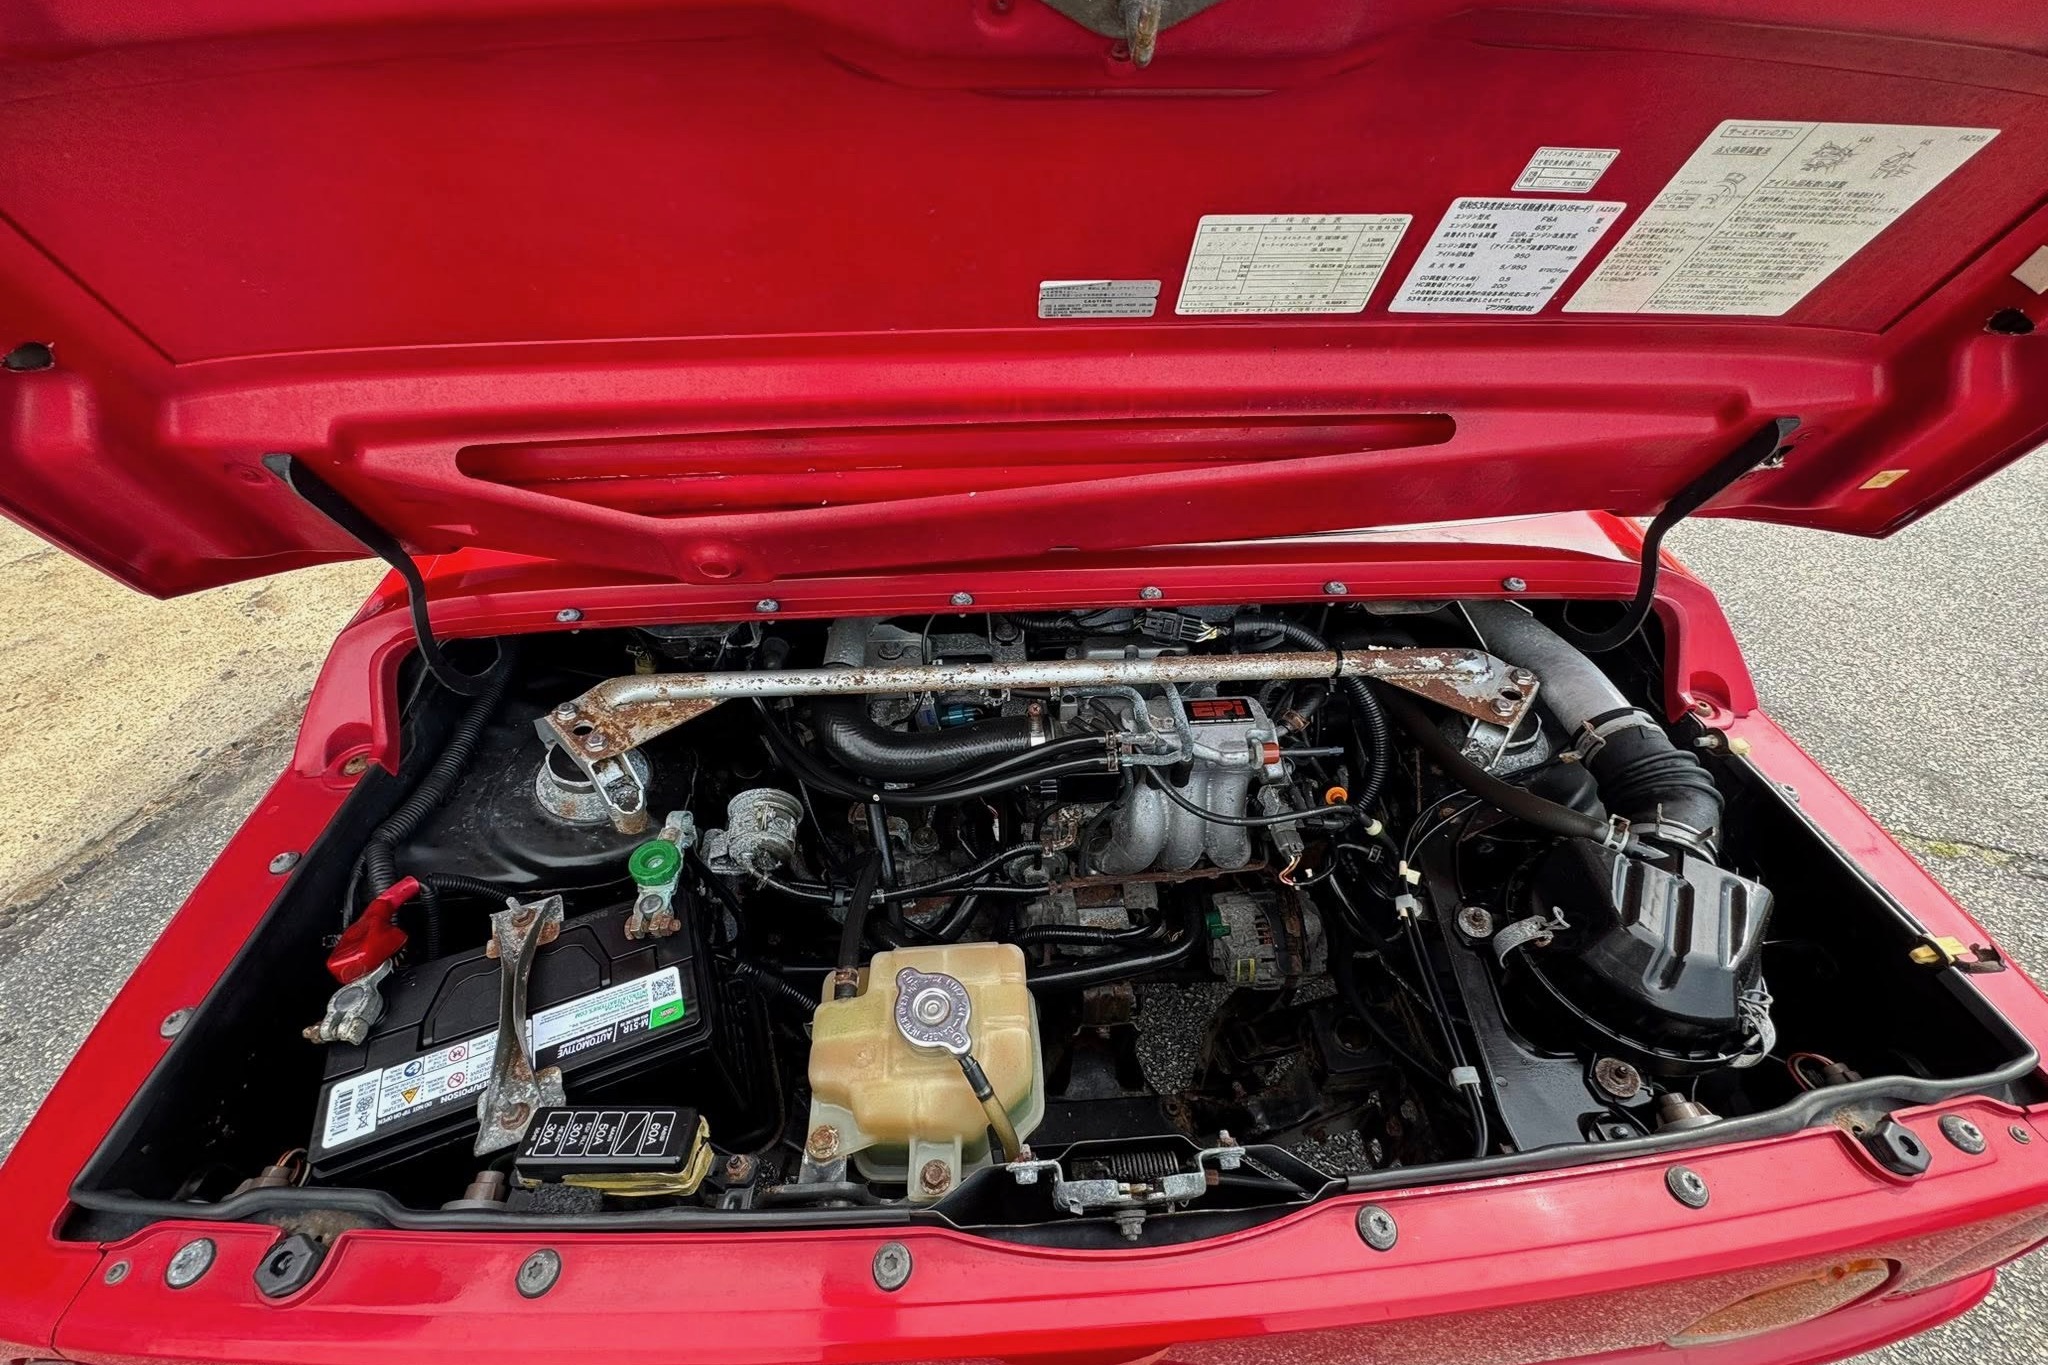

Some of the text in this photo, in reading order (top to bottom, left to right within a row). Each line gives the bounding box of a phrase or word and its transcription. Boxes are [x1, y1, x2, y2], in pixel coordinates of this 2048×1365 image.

[622, 1017, 648, 1034] M-51R
[556, 1029, 612, 1059] AUTOMOTIVE
[401, 1107, 411, 1116] TIP
[412, 1102, 424, 1112] NOT
[377, 1114, 393, 1125] OPEN
[540, 1123, 557, 1146] 30A
[566, 1123, 583, 1146] 30A
[592, 1123, 609, 1146] 50A
[645, 1122, 661, 1146] 60A
